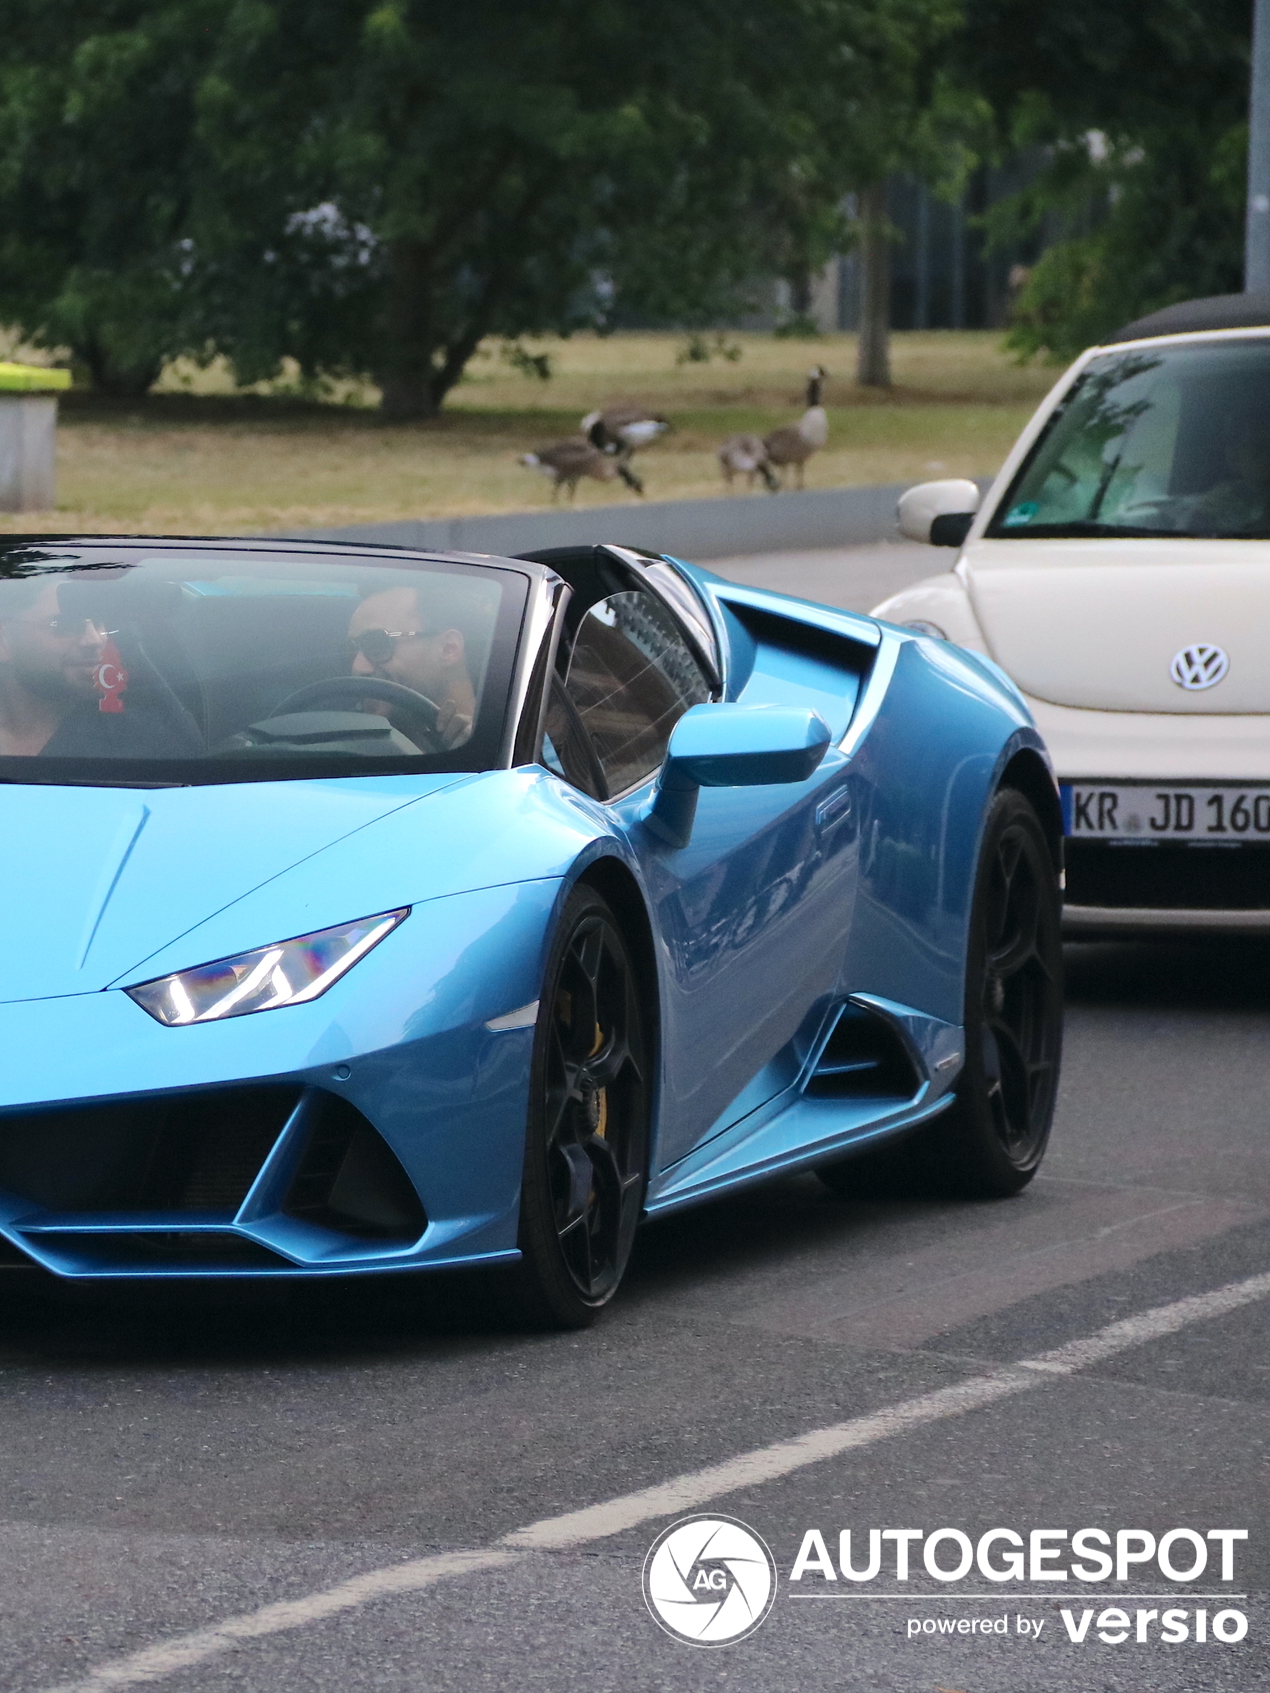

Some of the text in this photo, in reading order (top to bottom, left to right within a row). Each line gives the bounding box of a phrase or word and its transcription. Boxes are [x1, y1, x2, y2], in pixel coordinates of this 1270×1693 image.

[1172, 644, 1229, 690] VW
[1074, 792, 1270, 833] KR JD 160
